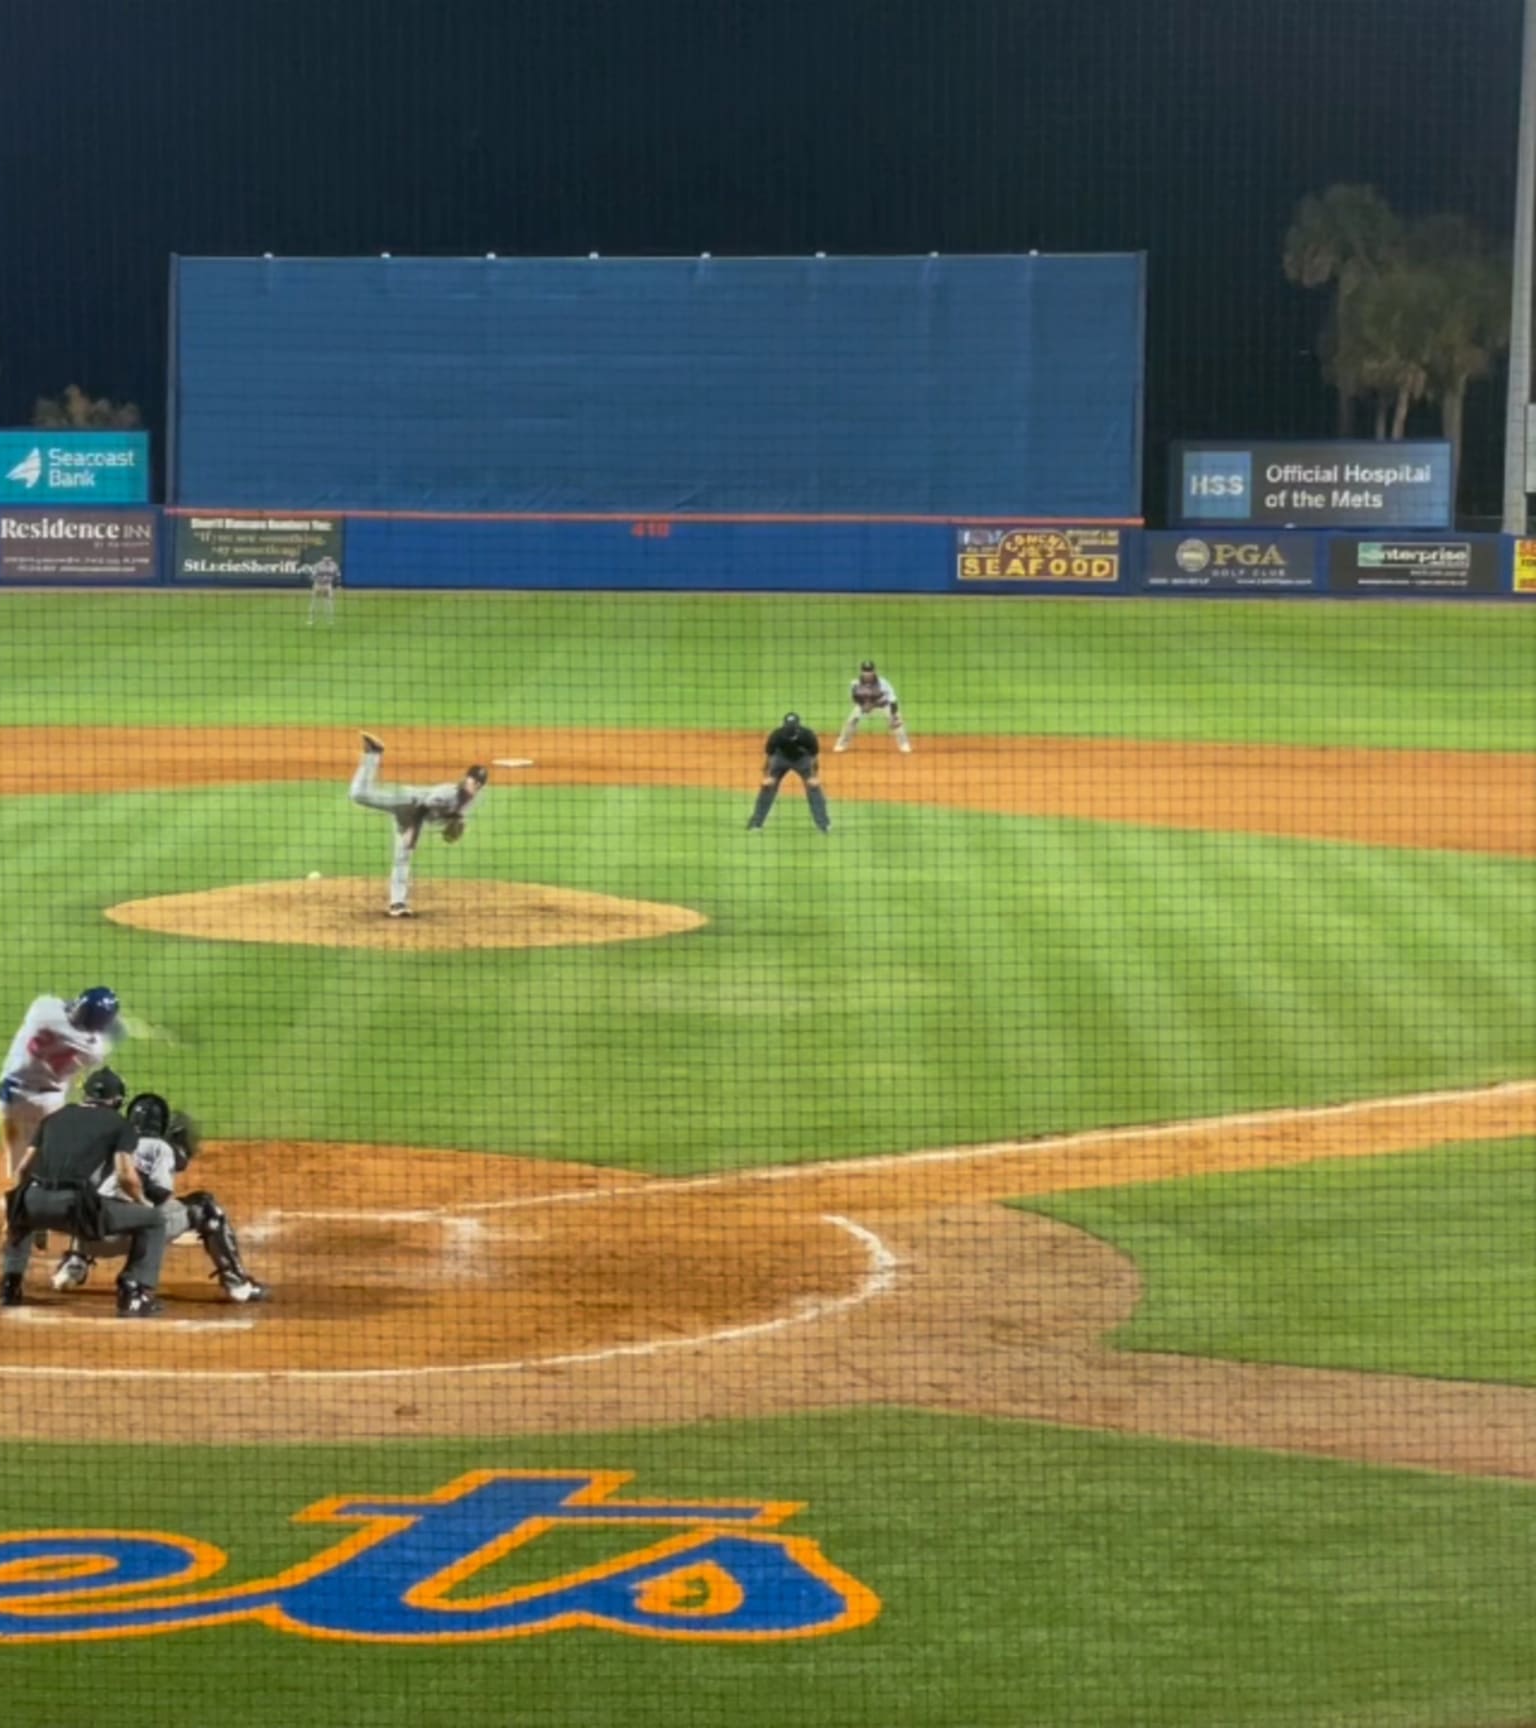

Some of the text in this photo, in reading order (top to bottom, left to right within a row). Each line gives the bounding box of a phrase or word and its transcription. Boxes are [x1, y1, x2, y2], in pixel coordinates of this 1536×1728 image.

[49, 448, 134, 467] Seacoast
[49, 470, 95, 488] Bank
[1266, 464, 1431, 485] Official Hospital
[1191, 475, 1244, 496] HSS
[1265, 490, 1383, 508] of the Mets
[0, 517, 120, 540] Residence
[1213, 544, 1286, 566] PGA
[964, 558, 1111, 577] SEAFOOD
[1212, 569, 1286, 577] GOLF CLUB
